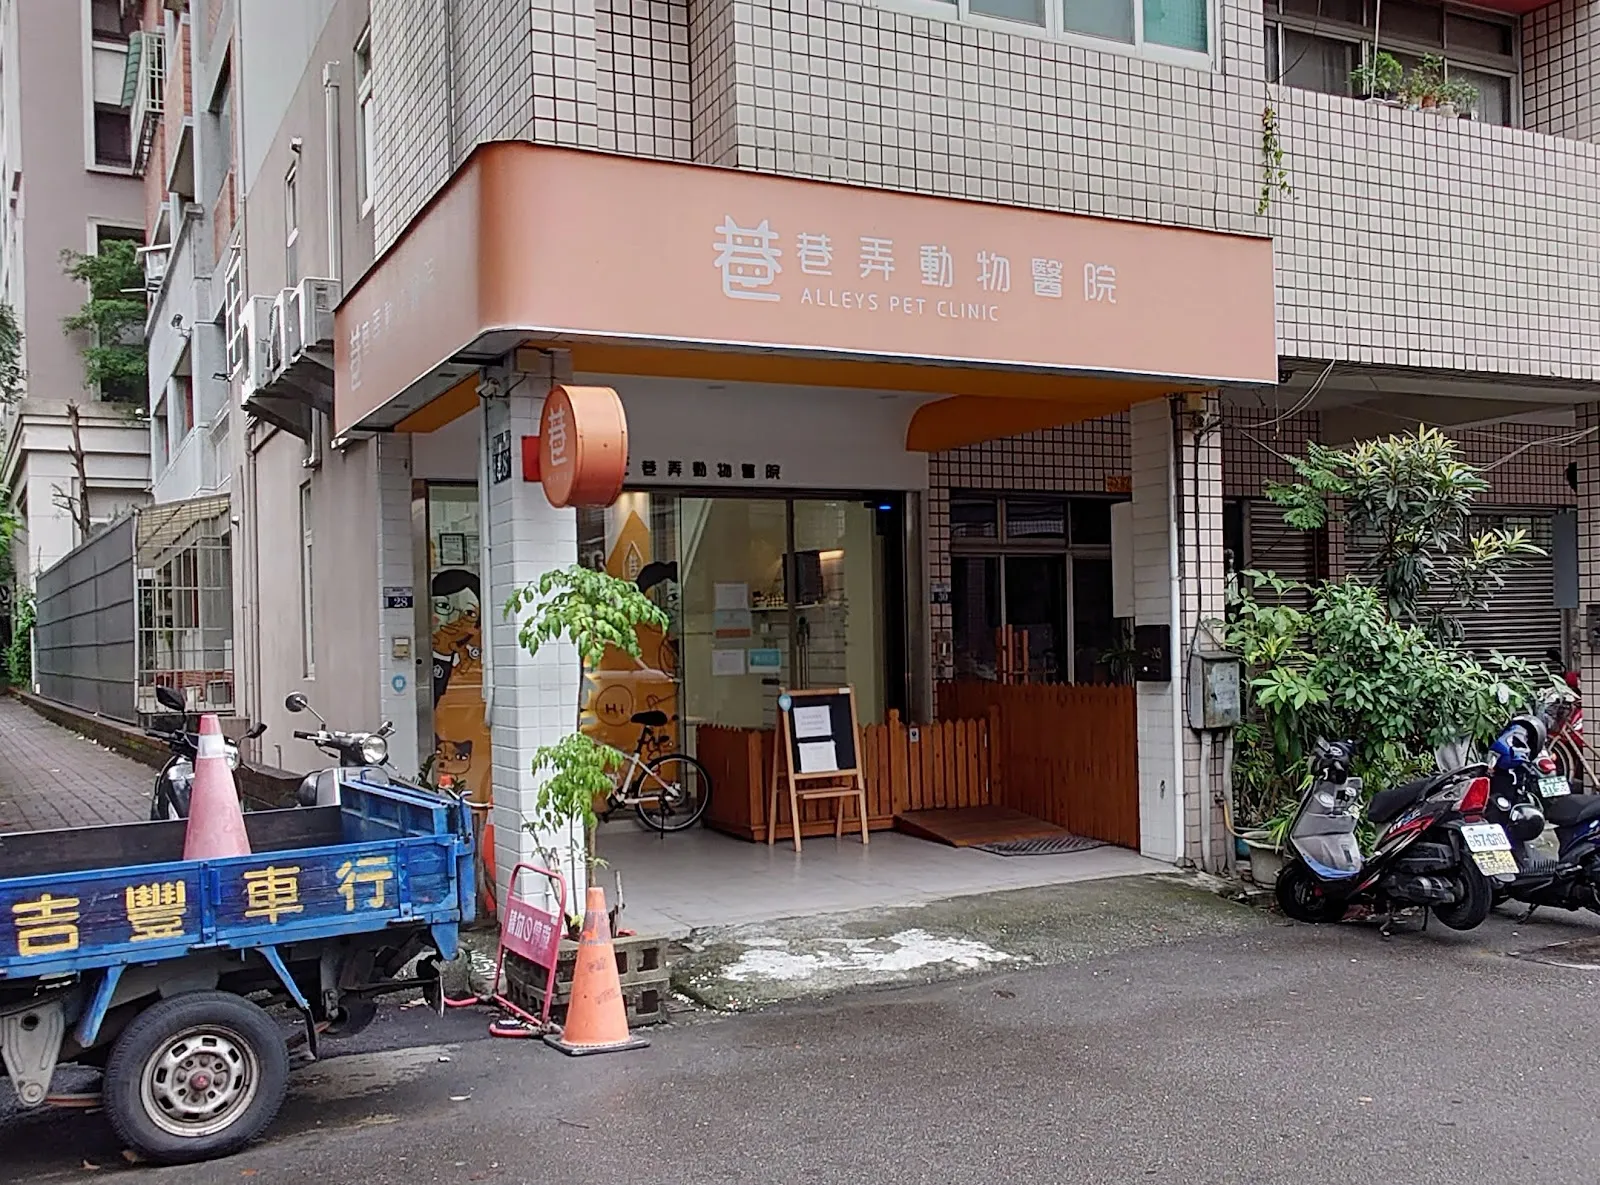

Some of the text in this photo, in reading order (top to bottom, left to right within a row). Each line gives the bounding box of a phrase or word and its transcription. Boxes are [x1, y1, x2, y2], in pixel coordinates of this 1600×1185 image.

[796, 232, 1117, 305] 巷弄動物醫院
[801, 289, 999, 321] ALLEYS PET CLINIC
[393, 597, 408, 608] 28
[11, 857, 394, 956] 吉豐車行
